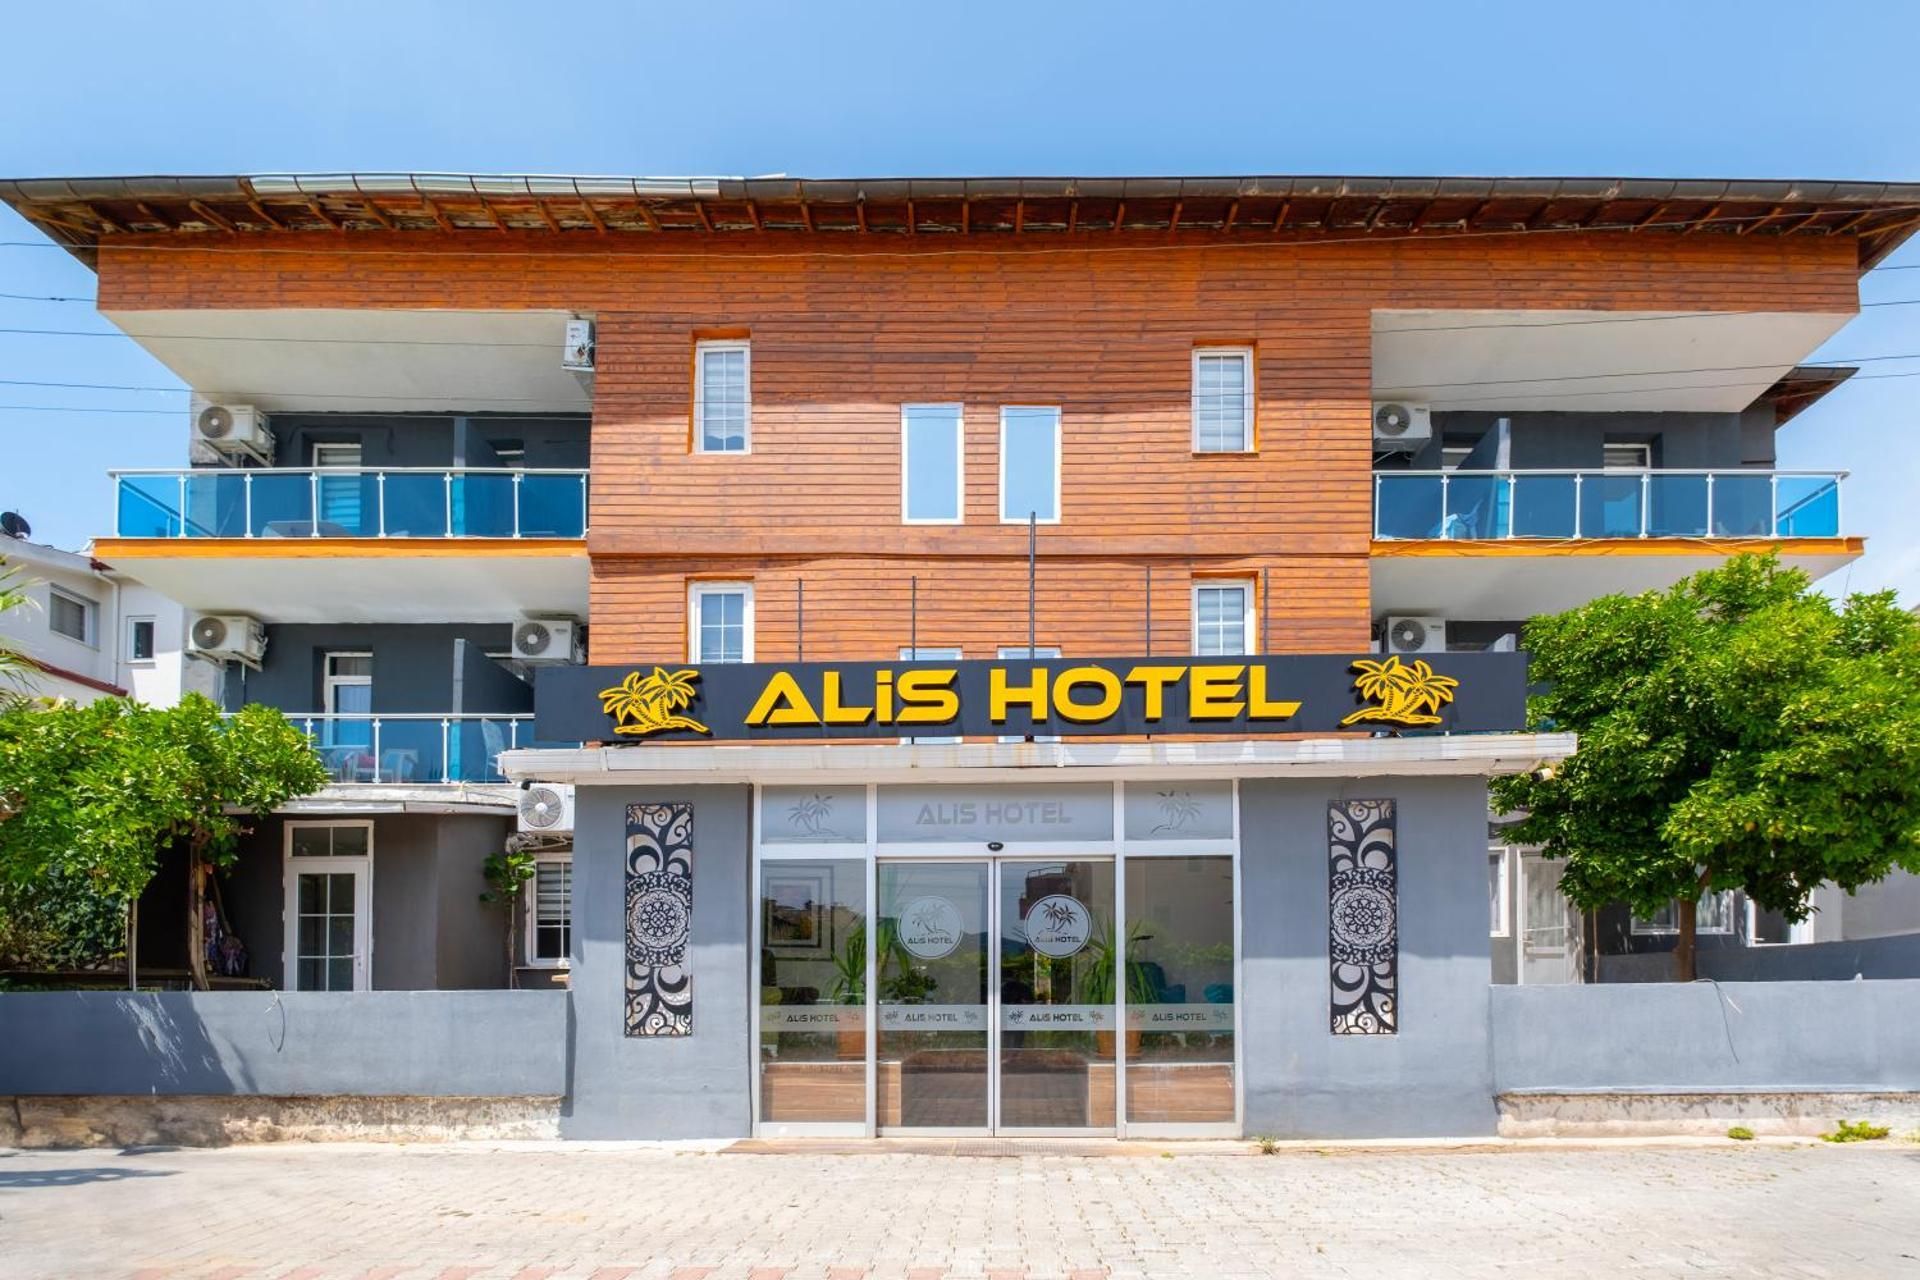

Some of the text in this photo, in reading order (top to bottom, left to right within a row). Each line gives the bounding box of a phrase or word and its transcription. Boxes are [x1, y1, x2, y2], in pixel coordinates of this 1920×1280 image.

[990, 665, 1302, 721] HOTEL
[985, 801, 1073, 825] HOTEL
[810, 1014, 840, 1022] HOTEL
[927, 1013, 958, 1022] HOTEL
[1053, 1013, 1083, 1022] HOTEL
[1175, 1012, 1207, 1021] HOTEL
